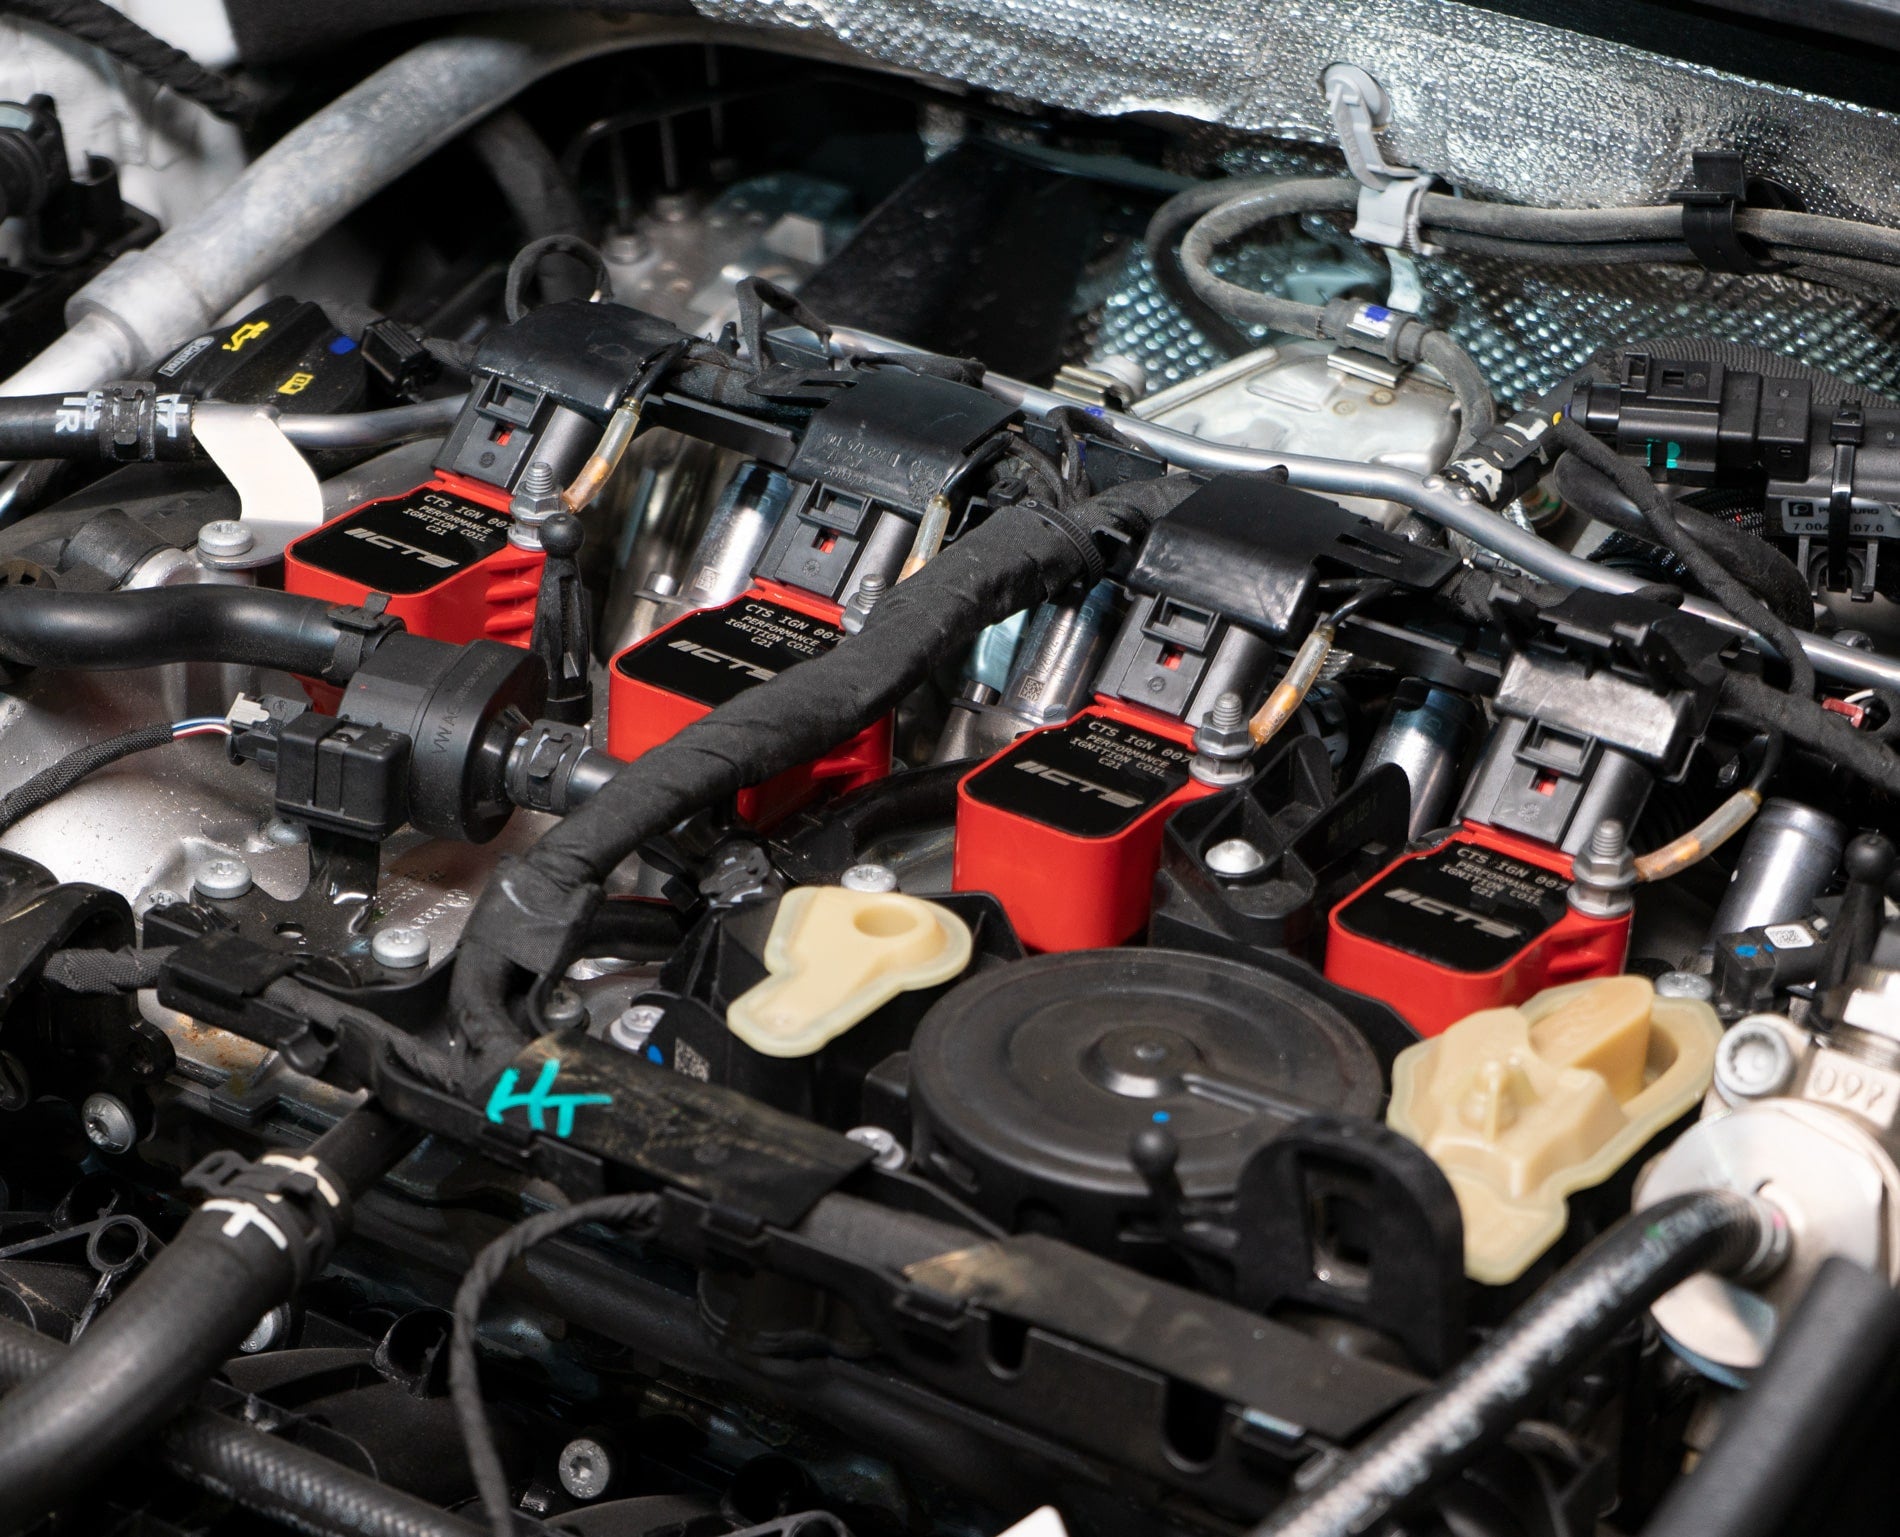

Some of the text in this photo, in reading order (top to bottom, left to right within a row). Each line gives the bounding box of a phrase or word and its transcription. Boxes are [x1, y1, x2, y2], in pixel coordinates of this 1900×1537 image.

[403, 507, 485, 542] IGNITION COIL
[419, 505, 493, 534] PERFORMANCE
[423, 494, 513, 530] CTS IGN 007
[1793, 523, 1884, 533] 7.004.07.0
[425, 524, 447, 536] C21
[725, 618, 815, 655] IGNITION COIL
[742, 615, 820, 647] PERFORMANCE
[744, 604, 845, 642] CTS IGN 007
[751, 636, 773, 649] C21
[1070, 737, 1166, 777] IGNITION COIL
[1086, 734, 1170, 769] PERFORMANCE
[1088, 721, 1194, 763] CTS IGN 007
[1098, 758, 1122, 771] C21
[1456, 847, 1489, 864] CTS
[1496, 861, 1529, 878] IGN
[1456, 861, 1546, 897] PERFORMANCE
[1439, 864, 1542, 906] IGNITION COIL
[1470, 885, 1496, 899] C21
